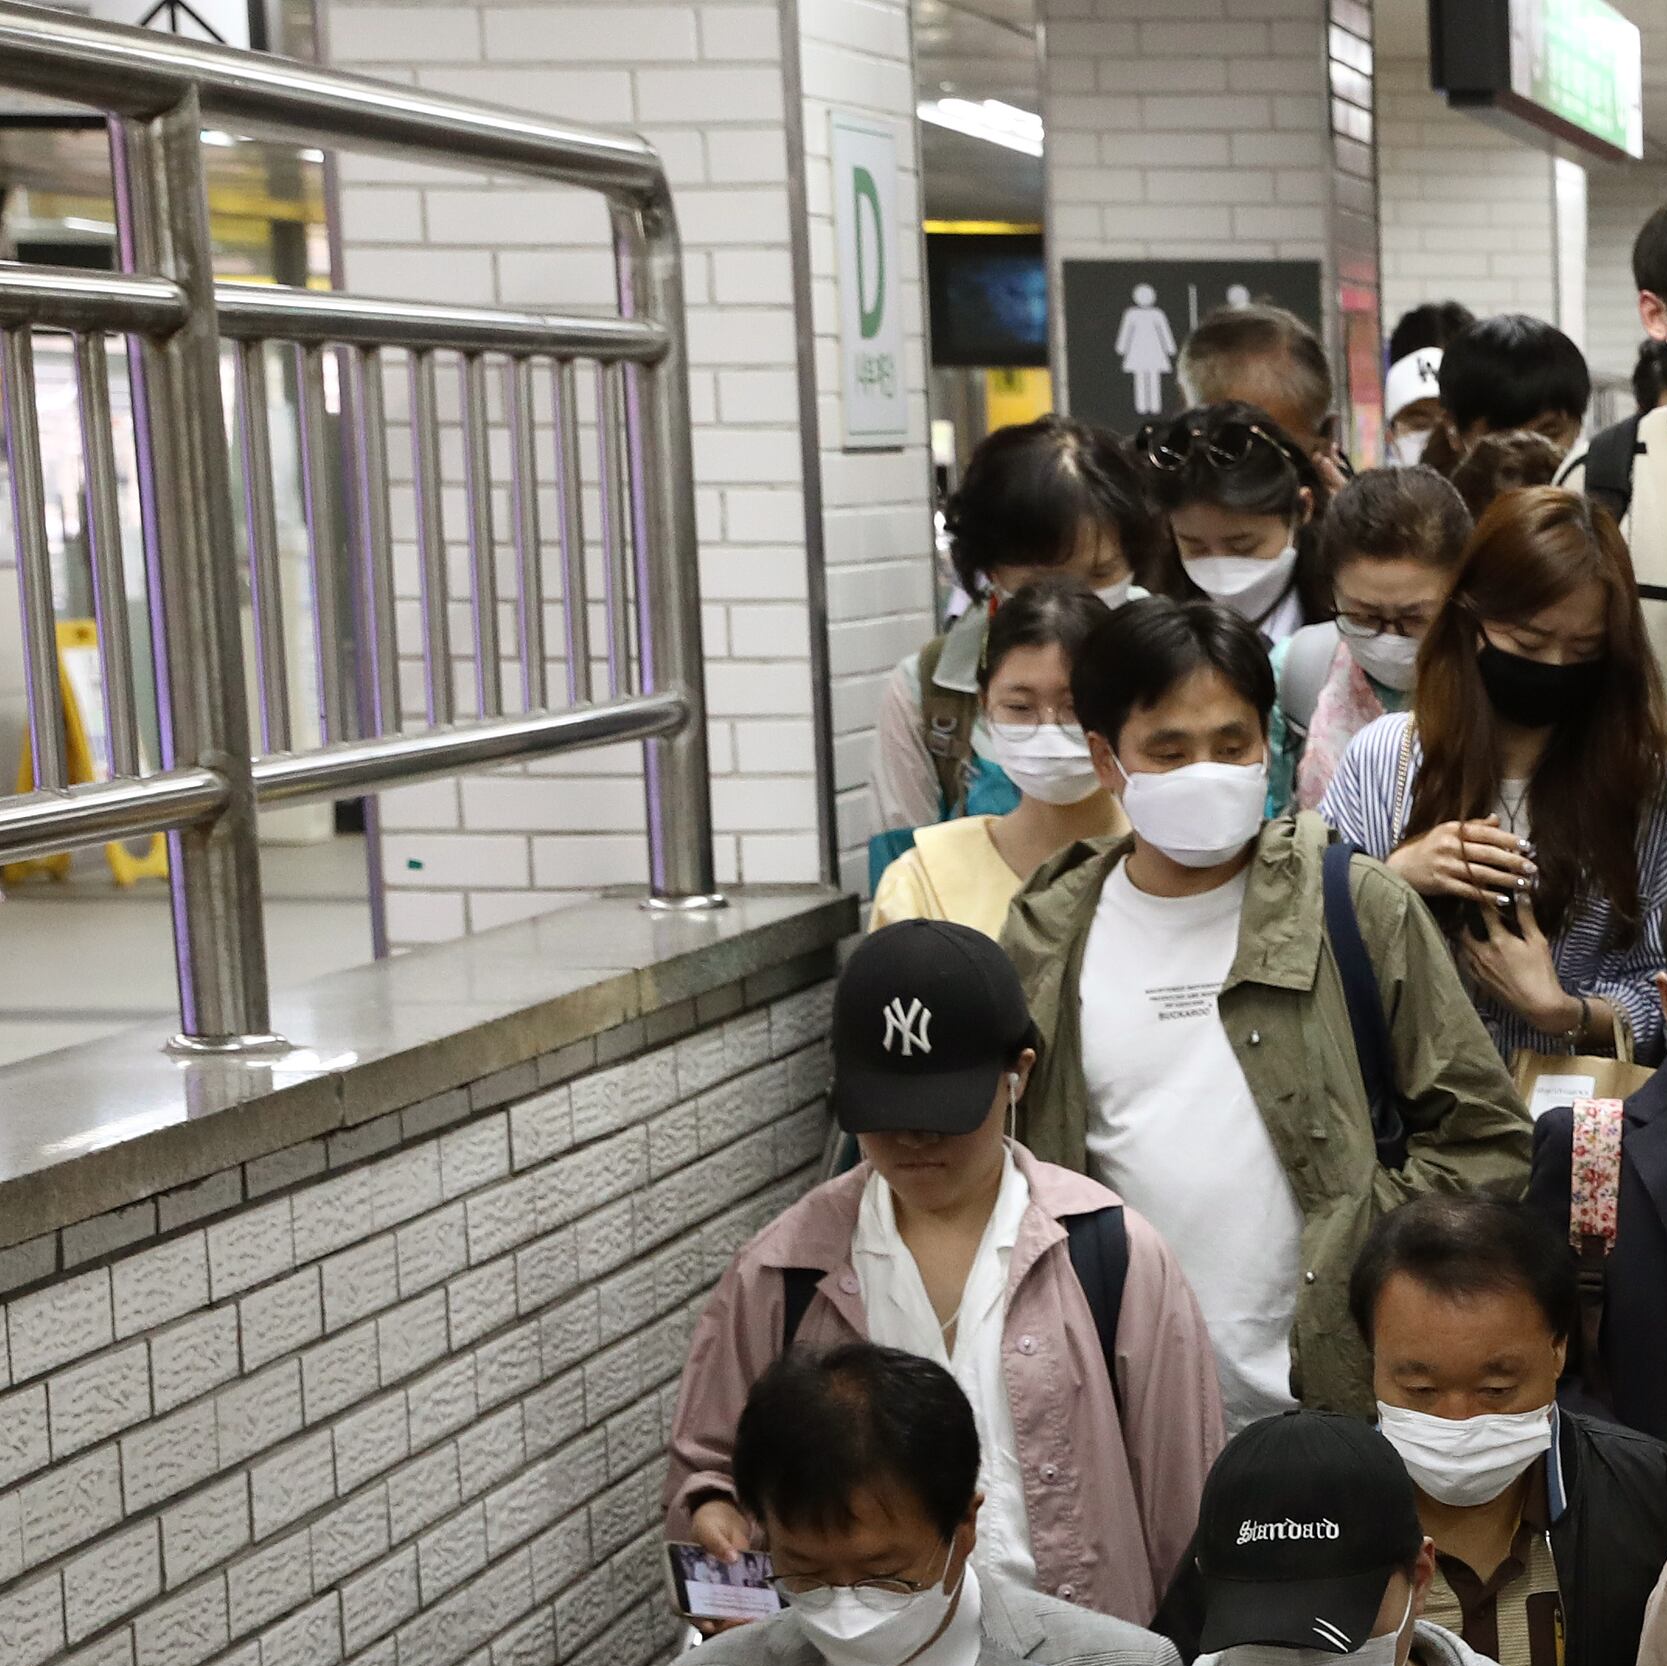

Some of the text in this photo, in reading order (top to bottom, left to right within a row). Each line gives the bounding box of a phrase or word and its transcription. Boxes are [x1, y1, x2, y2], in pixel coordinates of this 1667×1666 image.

[853, 166, 884, 338] D
[883, 997, 932, 1056] NY
[1236, 1517, 1341, 1545] Standard
